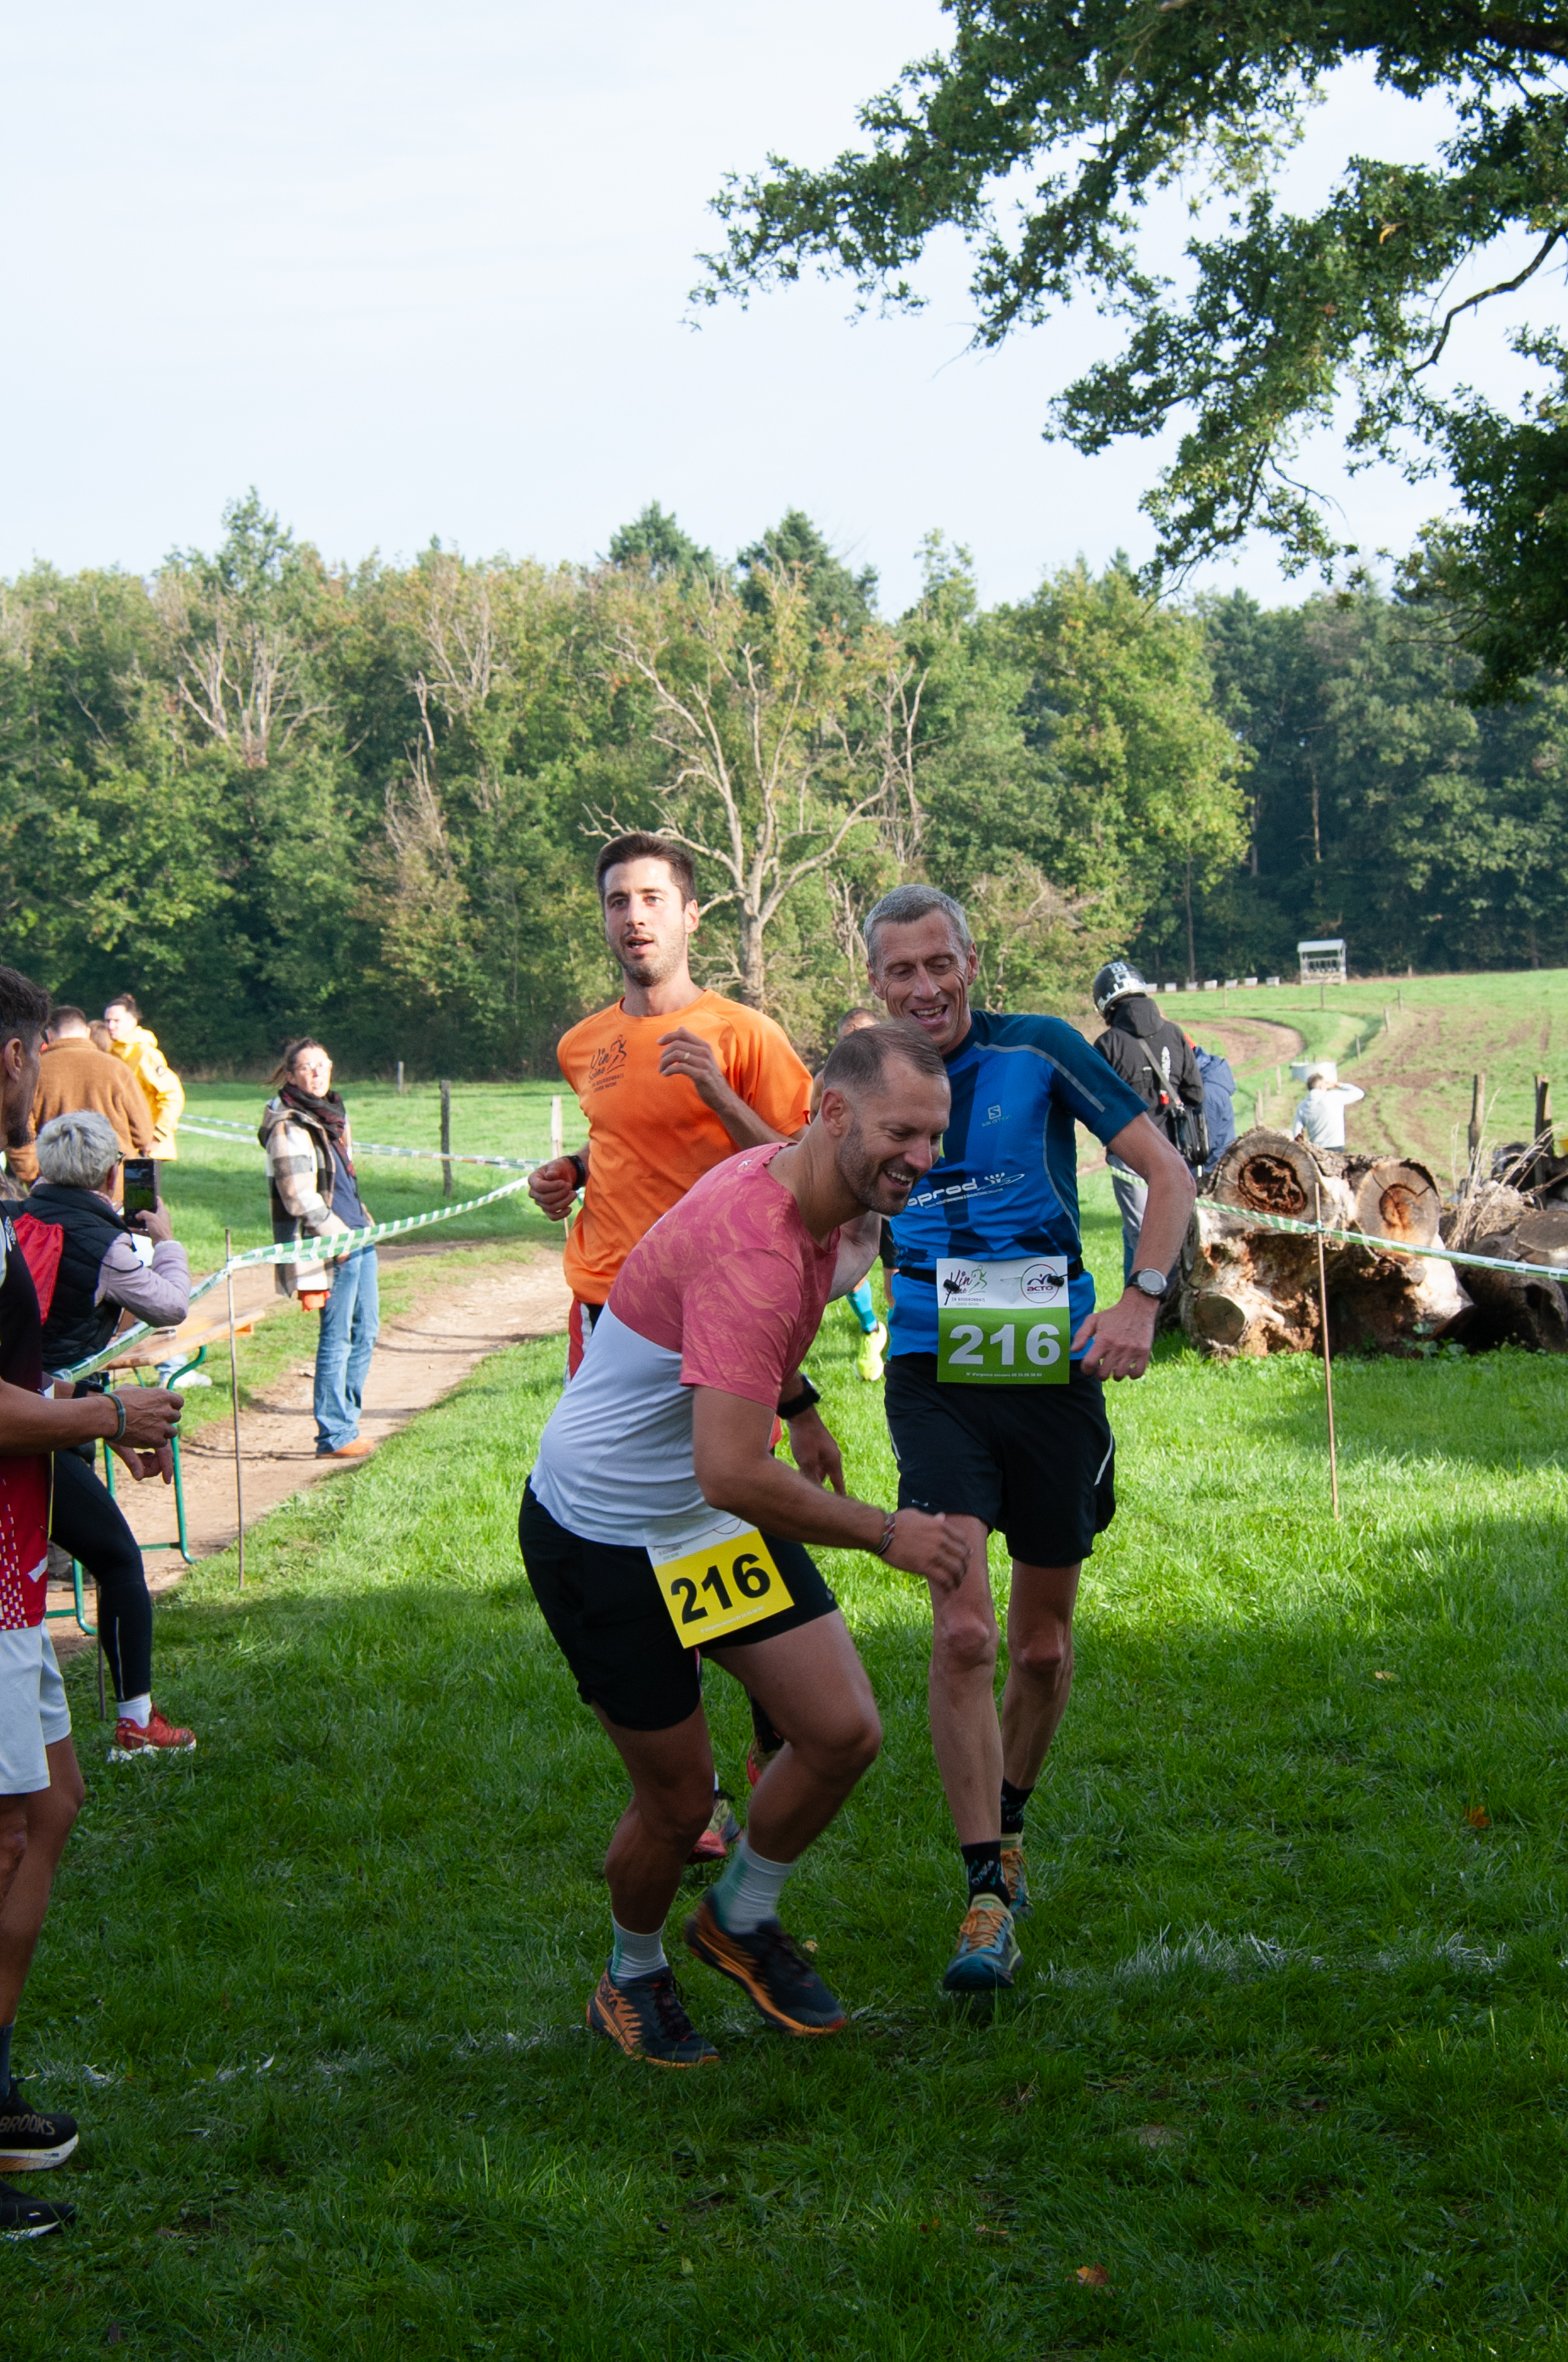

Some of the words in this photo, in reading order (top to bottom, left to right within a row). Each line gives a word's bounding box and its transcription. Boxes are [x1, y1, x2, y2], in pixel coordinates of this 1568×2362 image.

[948, 1323, 1061, 1366] 216
[670, 1553, 771, 1625] 216
[0, 2113, 56, 2136] BROOKS
